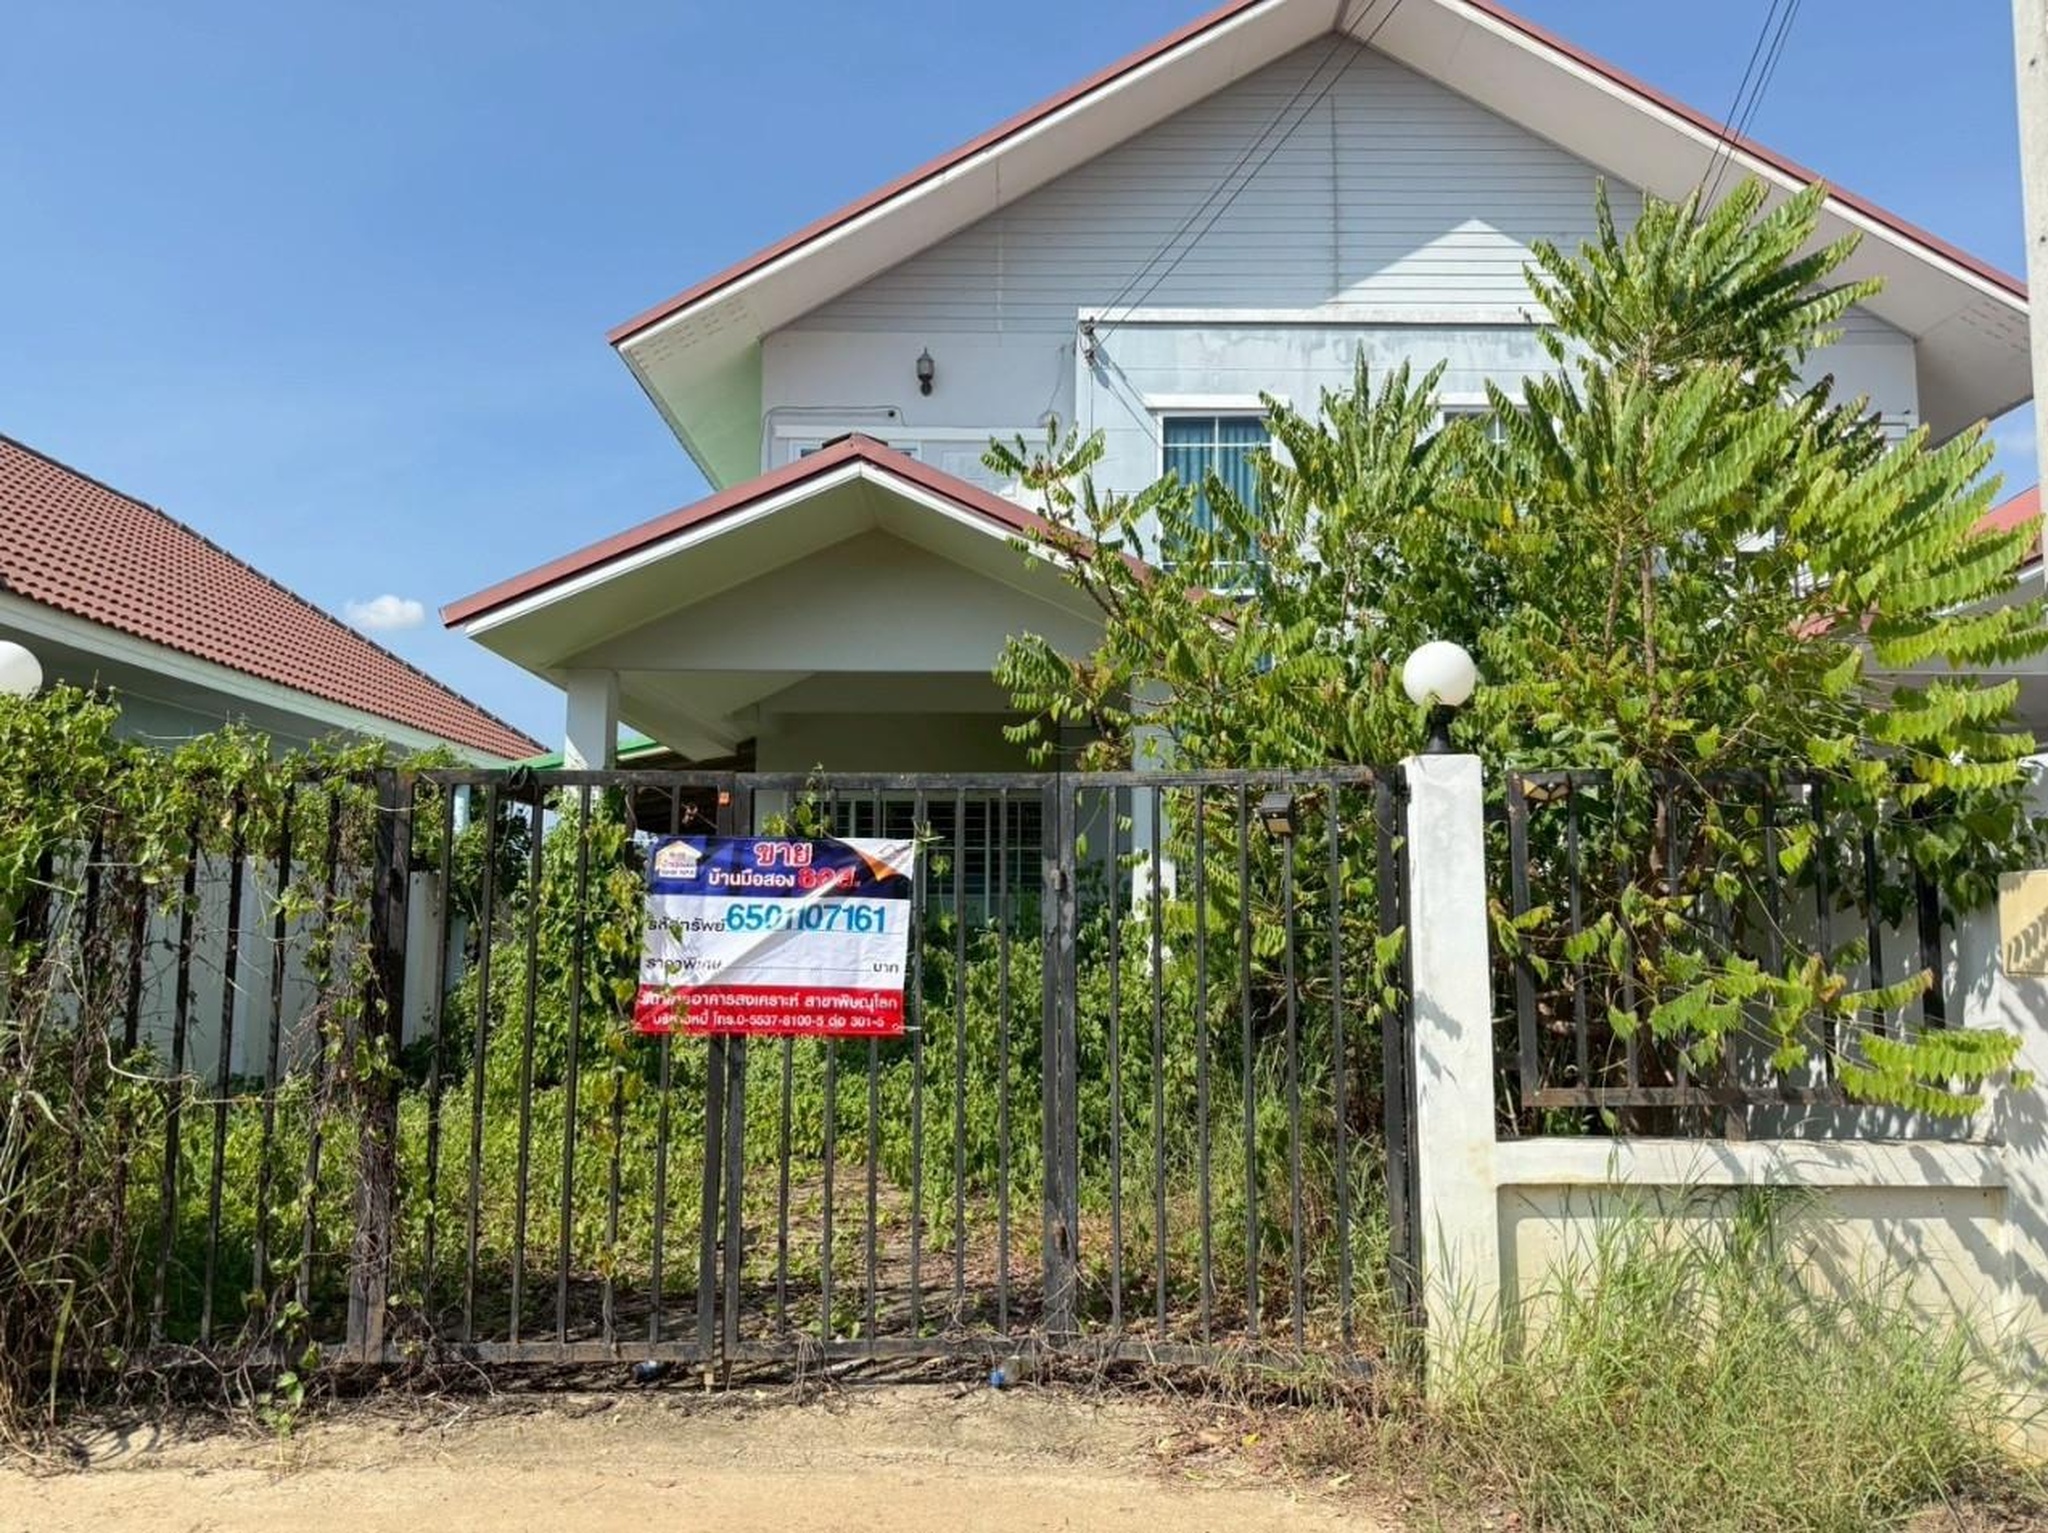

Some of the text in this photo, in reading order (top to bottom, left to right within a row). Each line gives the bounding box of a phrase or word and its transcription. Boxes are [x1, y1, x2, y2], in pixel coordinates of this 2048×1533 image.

[753, 842, 812, 867] ขาย
[708, 866, 794, 888] บ้านมือสอง
[647, 903, 886, 934] รหัทรัพย์ 6501107161
